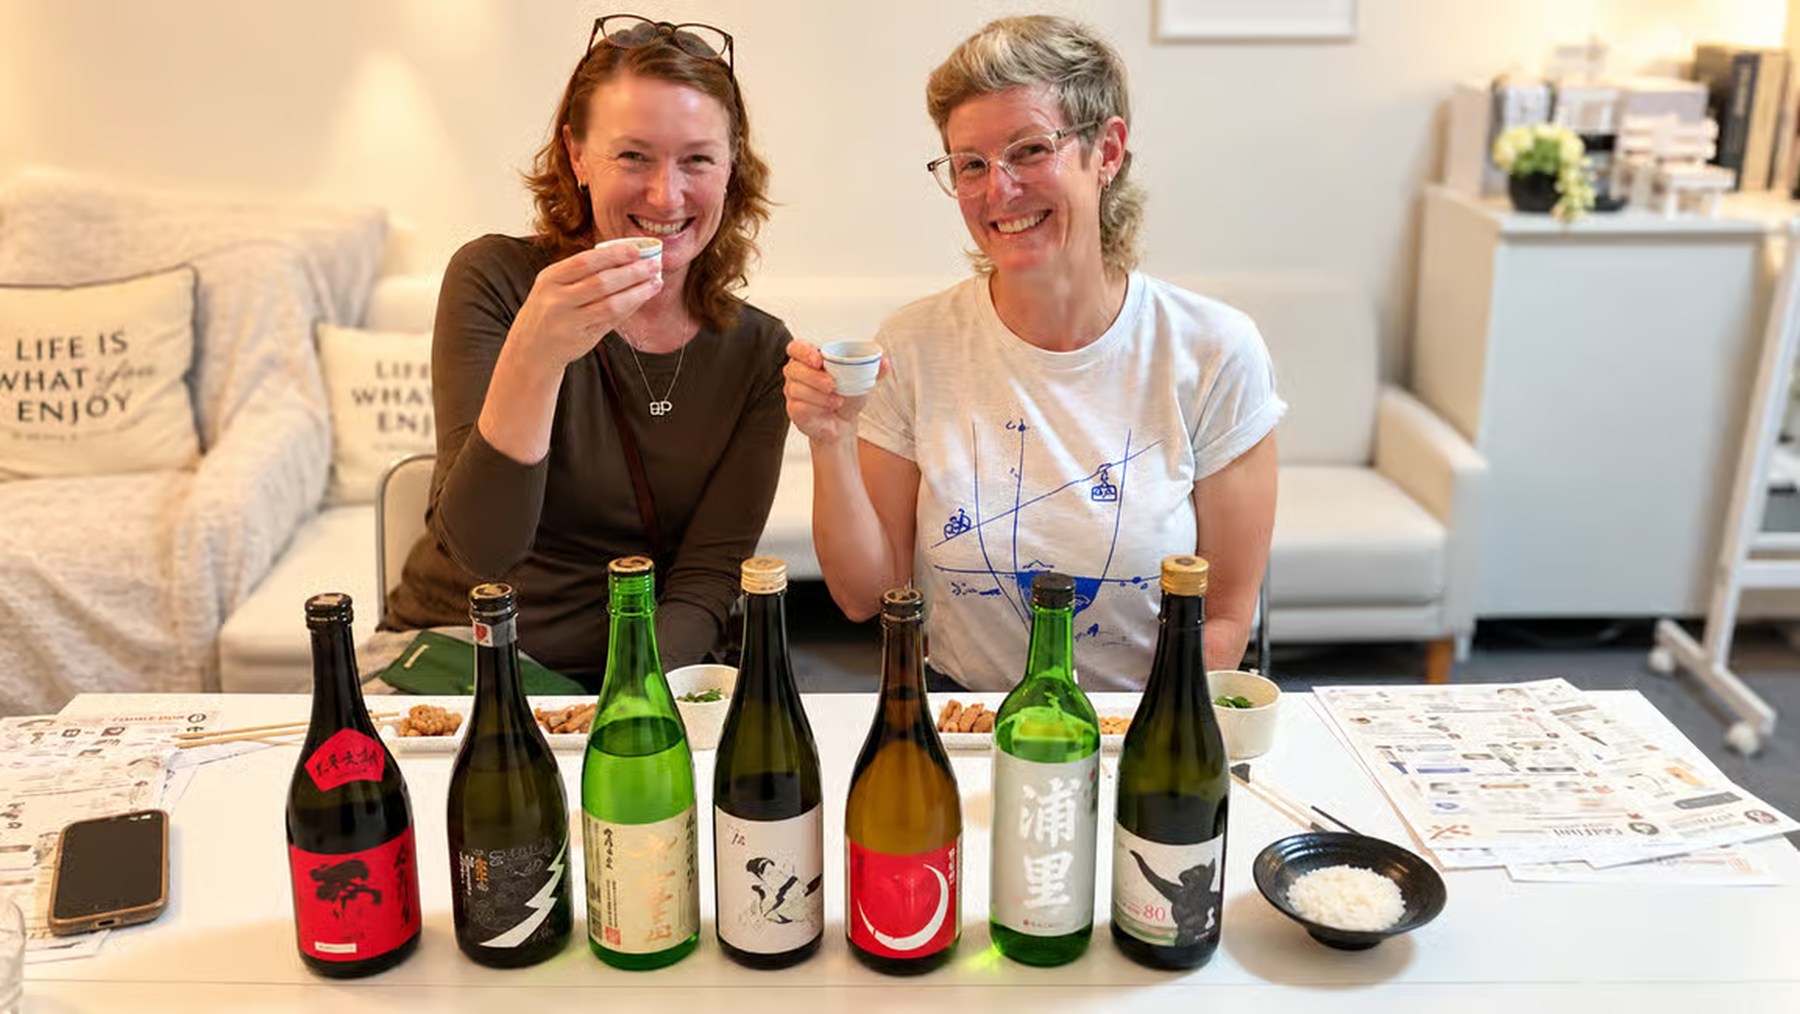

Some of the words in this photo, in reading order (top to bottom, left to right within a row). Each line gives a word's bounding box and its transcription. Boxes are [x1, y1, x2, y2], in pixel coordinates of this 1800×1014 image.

[16, 336, 85, 361] LIFE
[99, 330, 128, 355] IS
[0, 367, 88, 392] WHAT
[17, 390, 132, 426] ENJOY
[377, 411, 431, 438] ENJ
[1020, 777, 1081, 909] 浦里
[1143, 904, 1166, 921] 80
